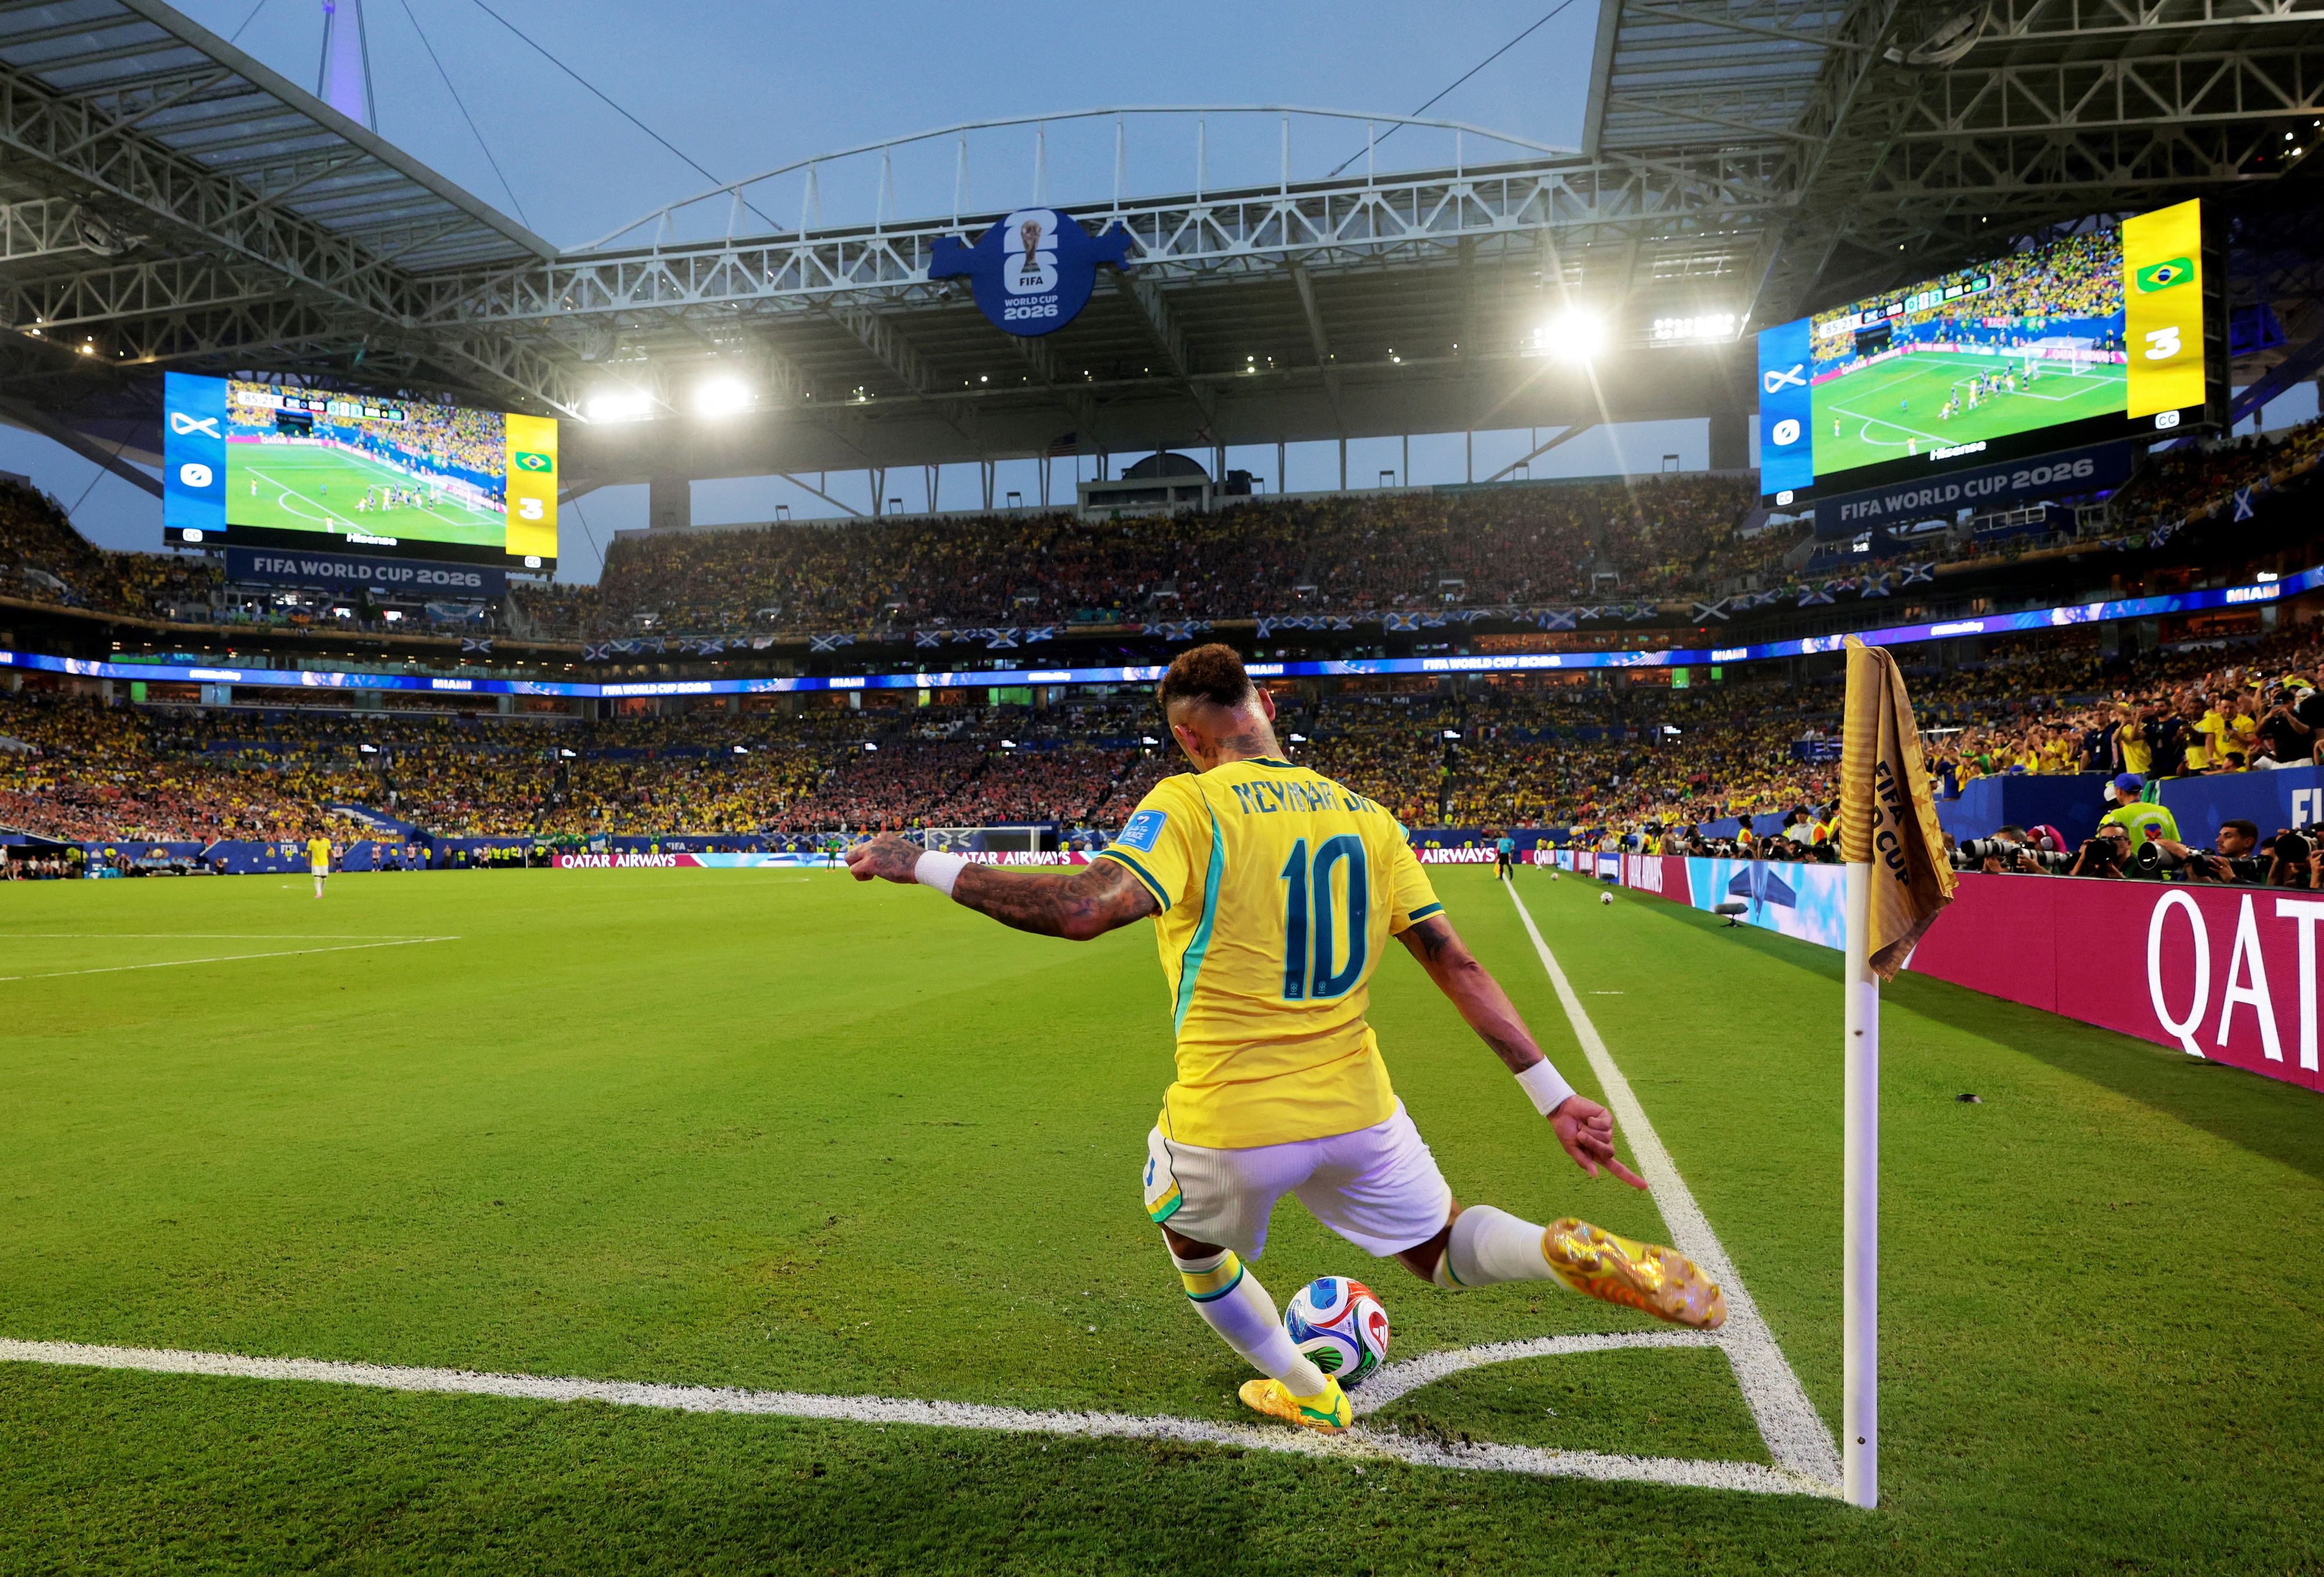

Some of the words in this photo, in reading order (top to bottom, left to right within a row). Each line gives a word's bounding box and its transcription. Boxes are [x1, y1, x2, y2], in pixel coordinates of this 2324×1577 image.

[1020, 277, 1043, 286] FIFA
[1005, 297, 1038, 307] WORLD
[1039, 295, 1058, 303] CUP
[1004, 304, 1058, 320] 2026
[1826, 319, 1853, 334] 85:21
[2145, 327, 2181, 360] 3
[245, 395, 274, 404] 85:21
[2158, 414, 2176, 425] CC
[1773, 420, 1800, 445] 0
[1930, 441, 1986, 461] Hisense
[180, 463, 213, 487] 0
[1841, 499, 1882, 521] FIFA
[1885, 485, 1960, 512] WORLD
[1964, 476, 2008, 498] CUP
[2012, 458, 2094, 489] 2026
[1778, 493, 1791, 502] CC
[519, 499, 543, 519] 3
[185, 531, 200, 540] CC
[347, 533, 397, 546] Hisense
[254, 557, 296, 574] FIFA
[300, 561, 372, 579] WORLD
[375, 567, 414, 582] CUP
[417, 570, 482, 587] 2026
[1712, 647, 1747, 661] MIAMI
[1245, 664, 1283, 675] MIAMI
[1423, 658, 1448, 670] FIFA
[1450, 657, 1493, 669] WORLD
[1493, 657, 1518, 668] CUP
[1519, 655, 1562, 667] 2026
[432, 678, 472, 690] MIAMI
[602, 685, 622, 696] FIFA
[623, 684, 657, 696] WORLD
[658, 683, 677, 694] CUP
[829, 678, 865, 688] MIAMI
[1231, 781, 1341, 814] NEYMAR
[1876, 760, 1906, 827] FIFA
[666, 842, 686, 851] FIFA
[561, 854, 611, 869] QATAR
[615, 854, 676, 867] AIRWAYS
[951, 851, 998, 865] ATAR
[1003, 851, 1071, 865] AIRWAYS
[1421, 847, 1496, 863] AIRWAYS
[1876, 830, 1909, 887] CUP
[1279, 834, 1368, 1001] 10
[2146, 889, 2324, 1073] QAT
